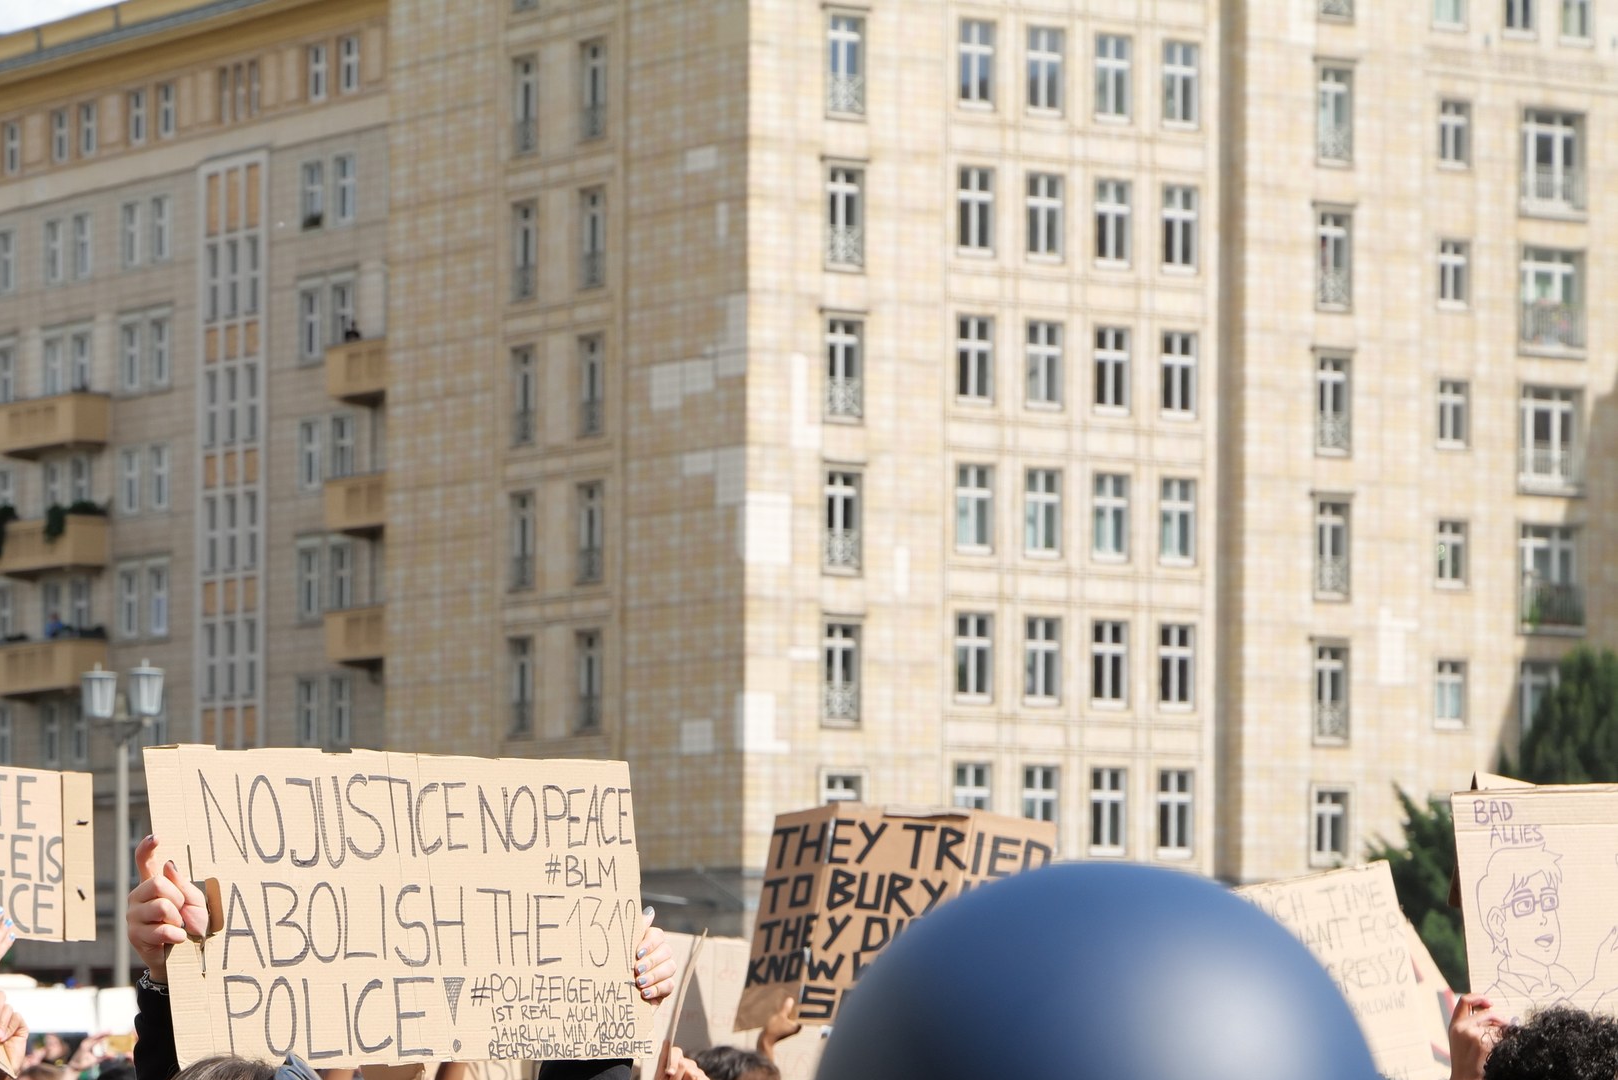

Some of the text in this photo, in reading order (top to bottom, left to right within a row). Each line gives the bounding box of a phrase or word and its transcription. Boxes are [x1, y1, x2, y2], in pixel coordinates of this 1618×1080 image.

[1473, 799, 1513, 824] BAD
[773, 819, 888, 869] THEY
[1490, 824, 1544, 848] ALLIES
[545, 853, 617, 892] #BLM
[763, 869, 948, 917] TO BURY
[1317, 880, 1386, 915] TIME
[222, 881, 467, 970] ABOLISH
[476, 887, 565, 967] THE
[759, 913, 852, 953] THEY
[1358, 911, 1405, 947] FOR
[745, 951, 845, 988] KNOW
[471, 973, 636, 1007] #POLIZEIGEWALT
[491, 1005, 514, 1023] IST
[567, 1005, 598, 1023] AUCH
[602, 1003, 615, 1023] IN
[489, 1041, 582, 1060] RECHTSWIDRIGE
[491, 1023, 556, 1043] JÄHRLICH
